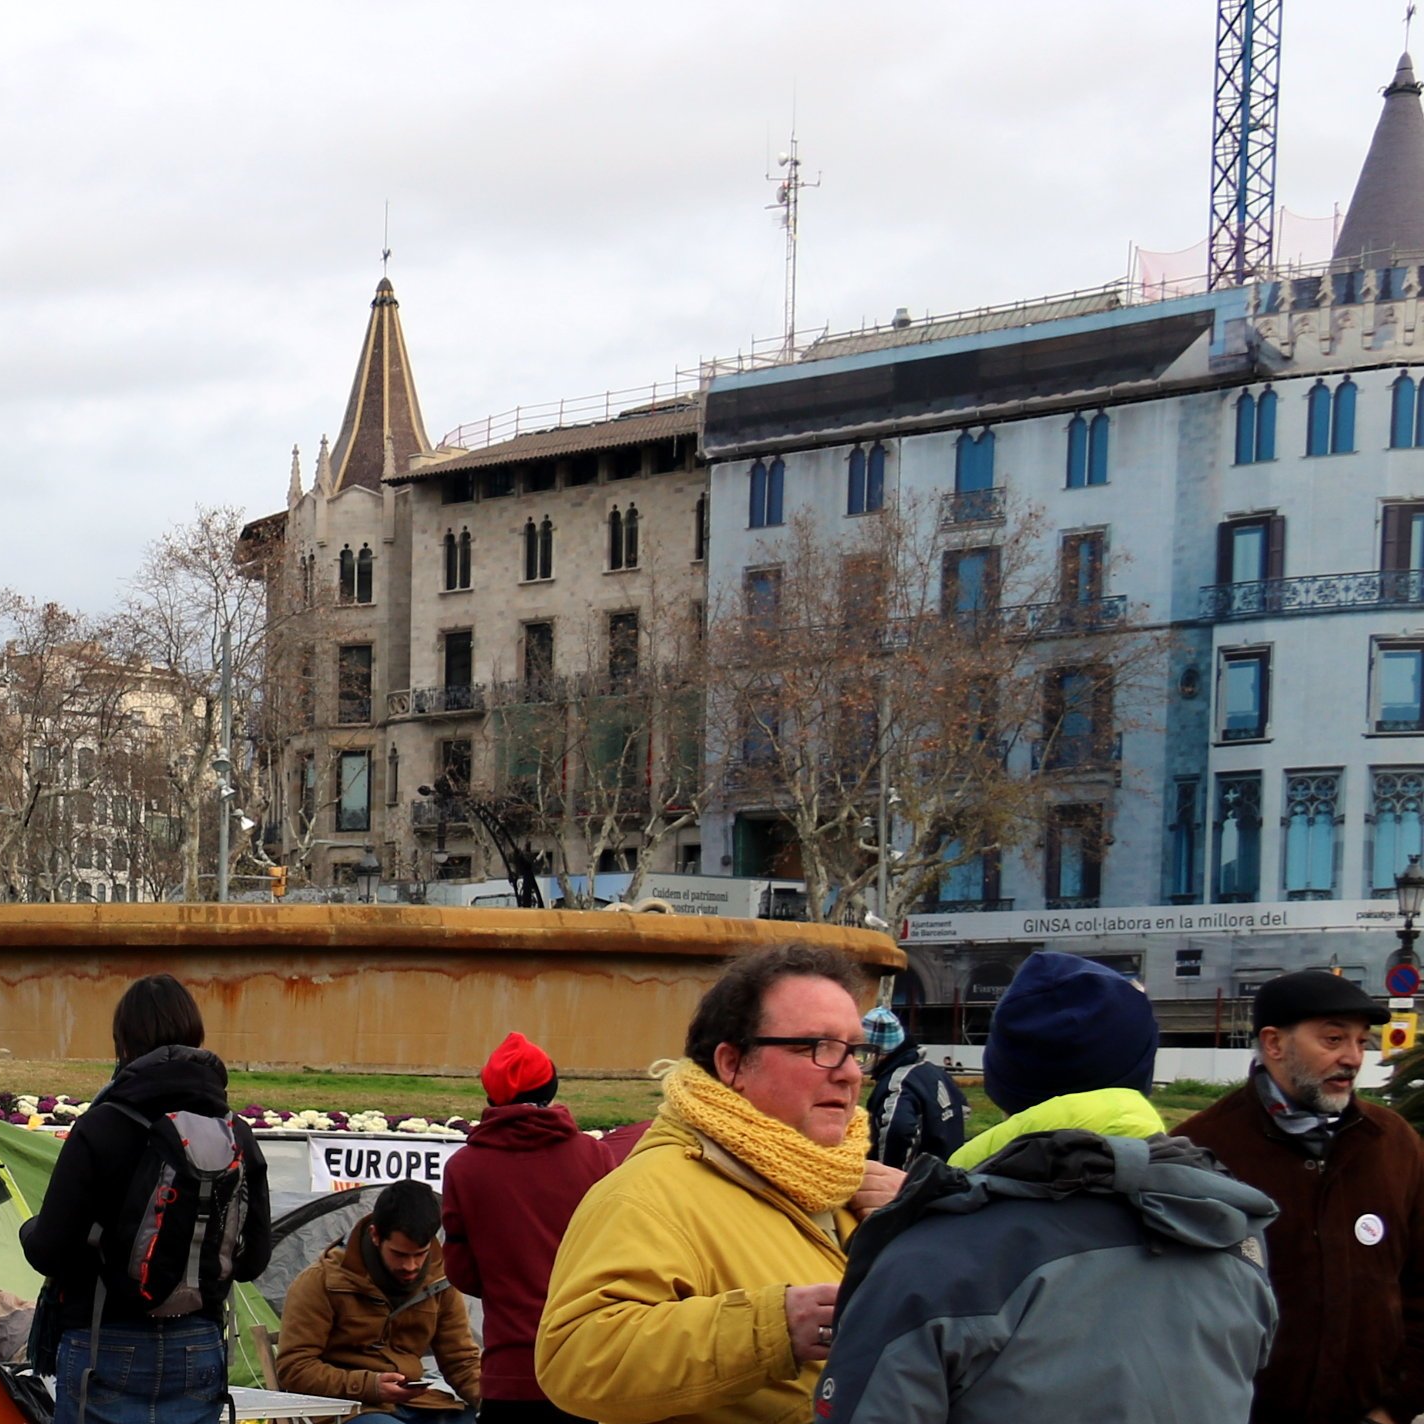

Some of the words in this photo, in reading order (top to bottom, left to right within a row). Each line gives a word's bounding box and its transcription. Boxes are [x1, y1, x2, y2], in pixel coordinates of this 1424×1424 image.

[652, 887, 682, 900] Cuidem
[683, 889, 690, 901] el
[691, 890, 729, 903] patrimoni
[1023, 918, 1071, 934] GINSA
[1156, 918, 1174, 930] en
[1179, 915, 1194, 928] la
[1198, 912, 1255, 929] millora
[1260, 911, 1288, 927] del
[324, 1147, 441, 1180] EUROPE
